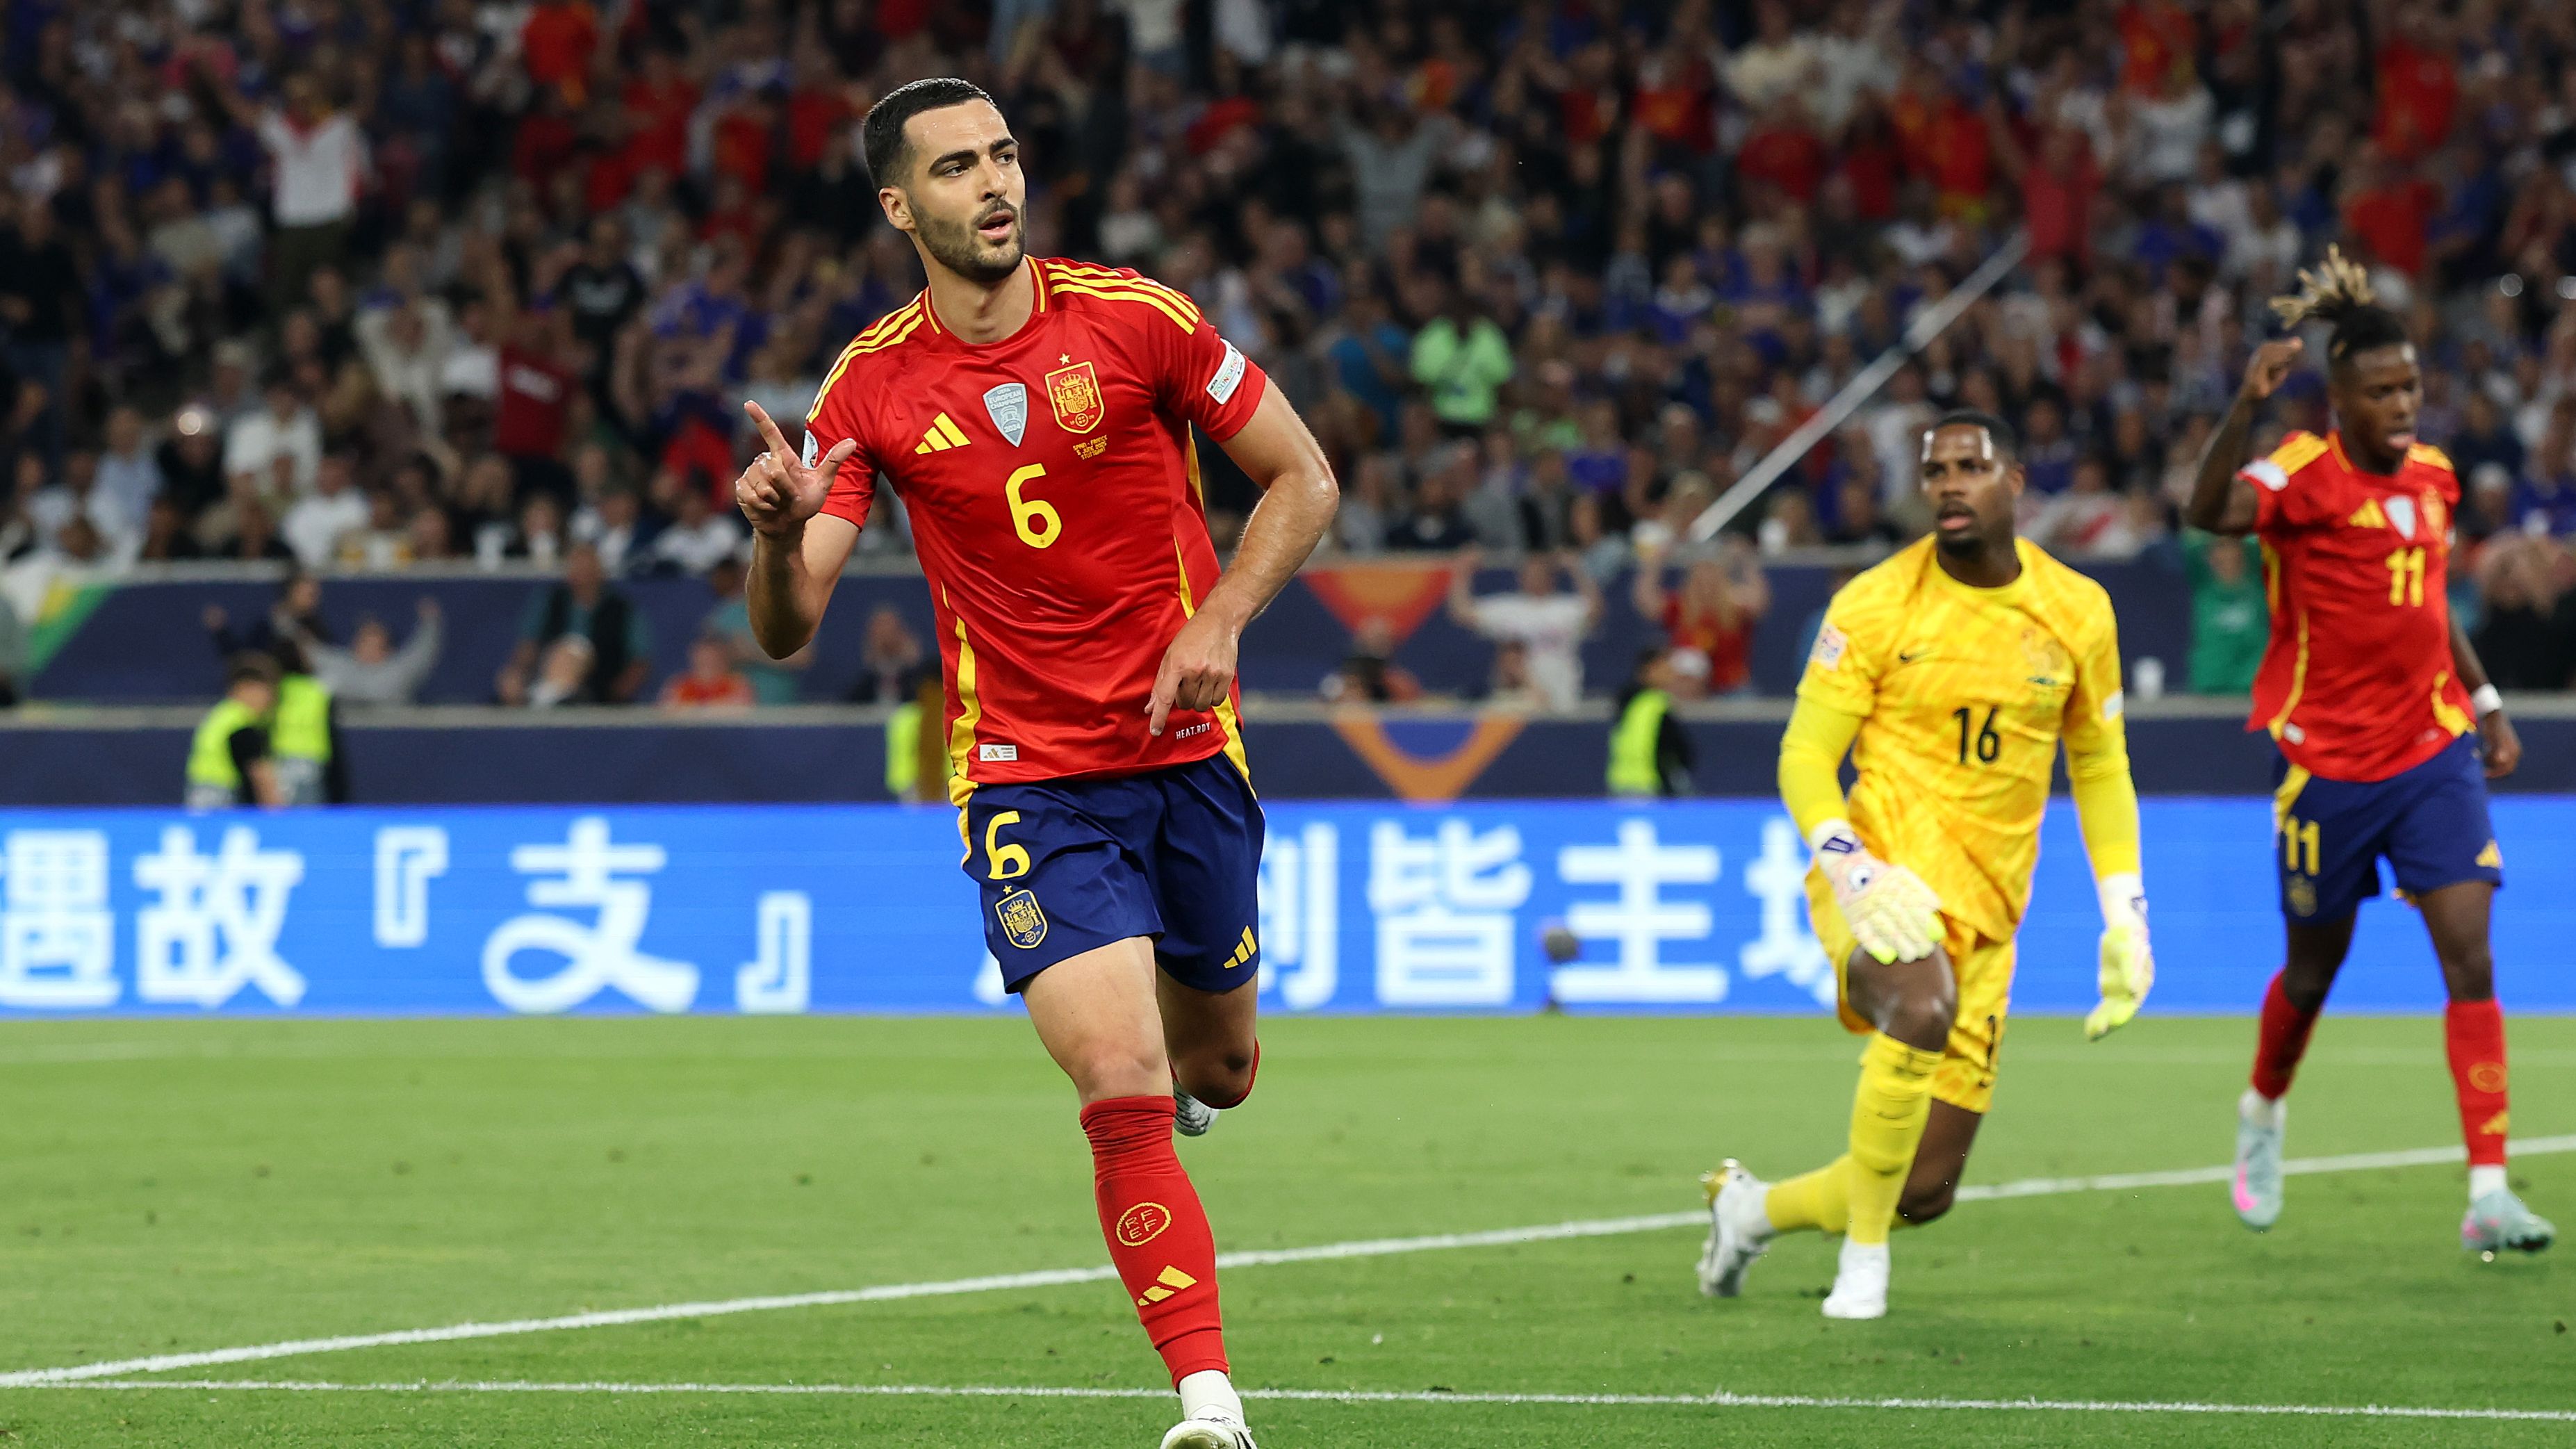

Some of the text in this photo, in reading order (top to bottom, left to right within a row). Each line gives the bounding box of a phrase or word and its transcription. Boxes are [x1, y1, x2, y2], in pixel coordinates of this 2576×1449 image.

[988, 390, 1022, 404] EUROPEAN
[990, 395, 1024, 409] CHAMPIONS
[1004, 463, 1062, 549] 6
[2385, 546, 2426, 607] 11
[1176, 721, 1211, 740] HEAT.RDY
[1953, 705, 2001, 765] 16
[985, 811, 1031, 880] 6
[2284, 814, 2321, 876] 11
